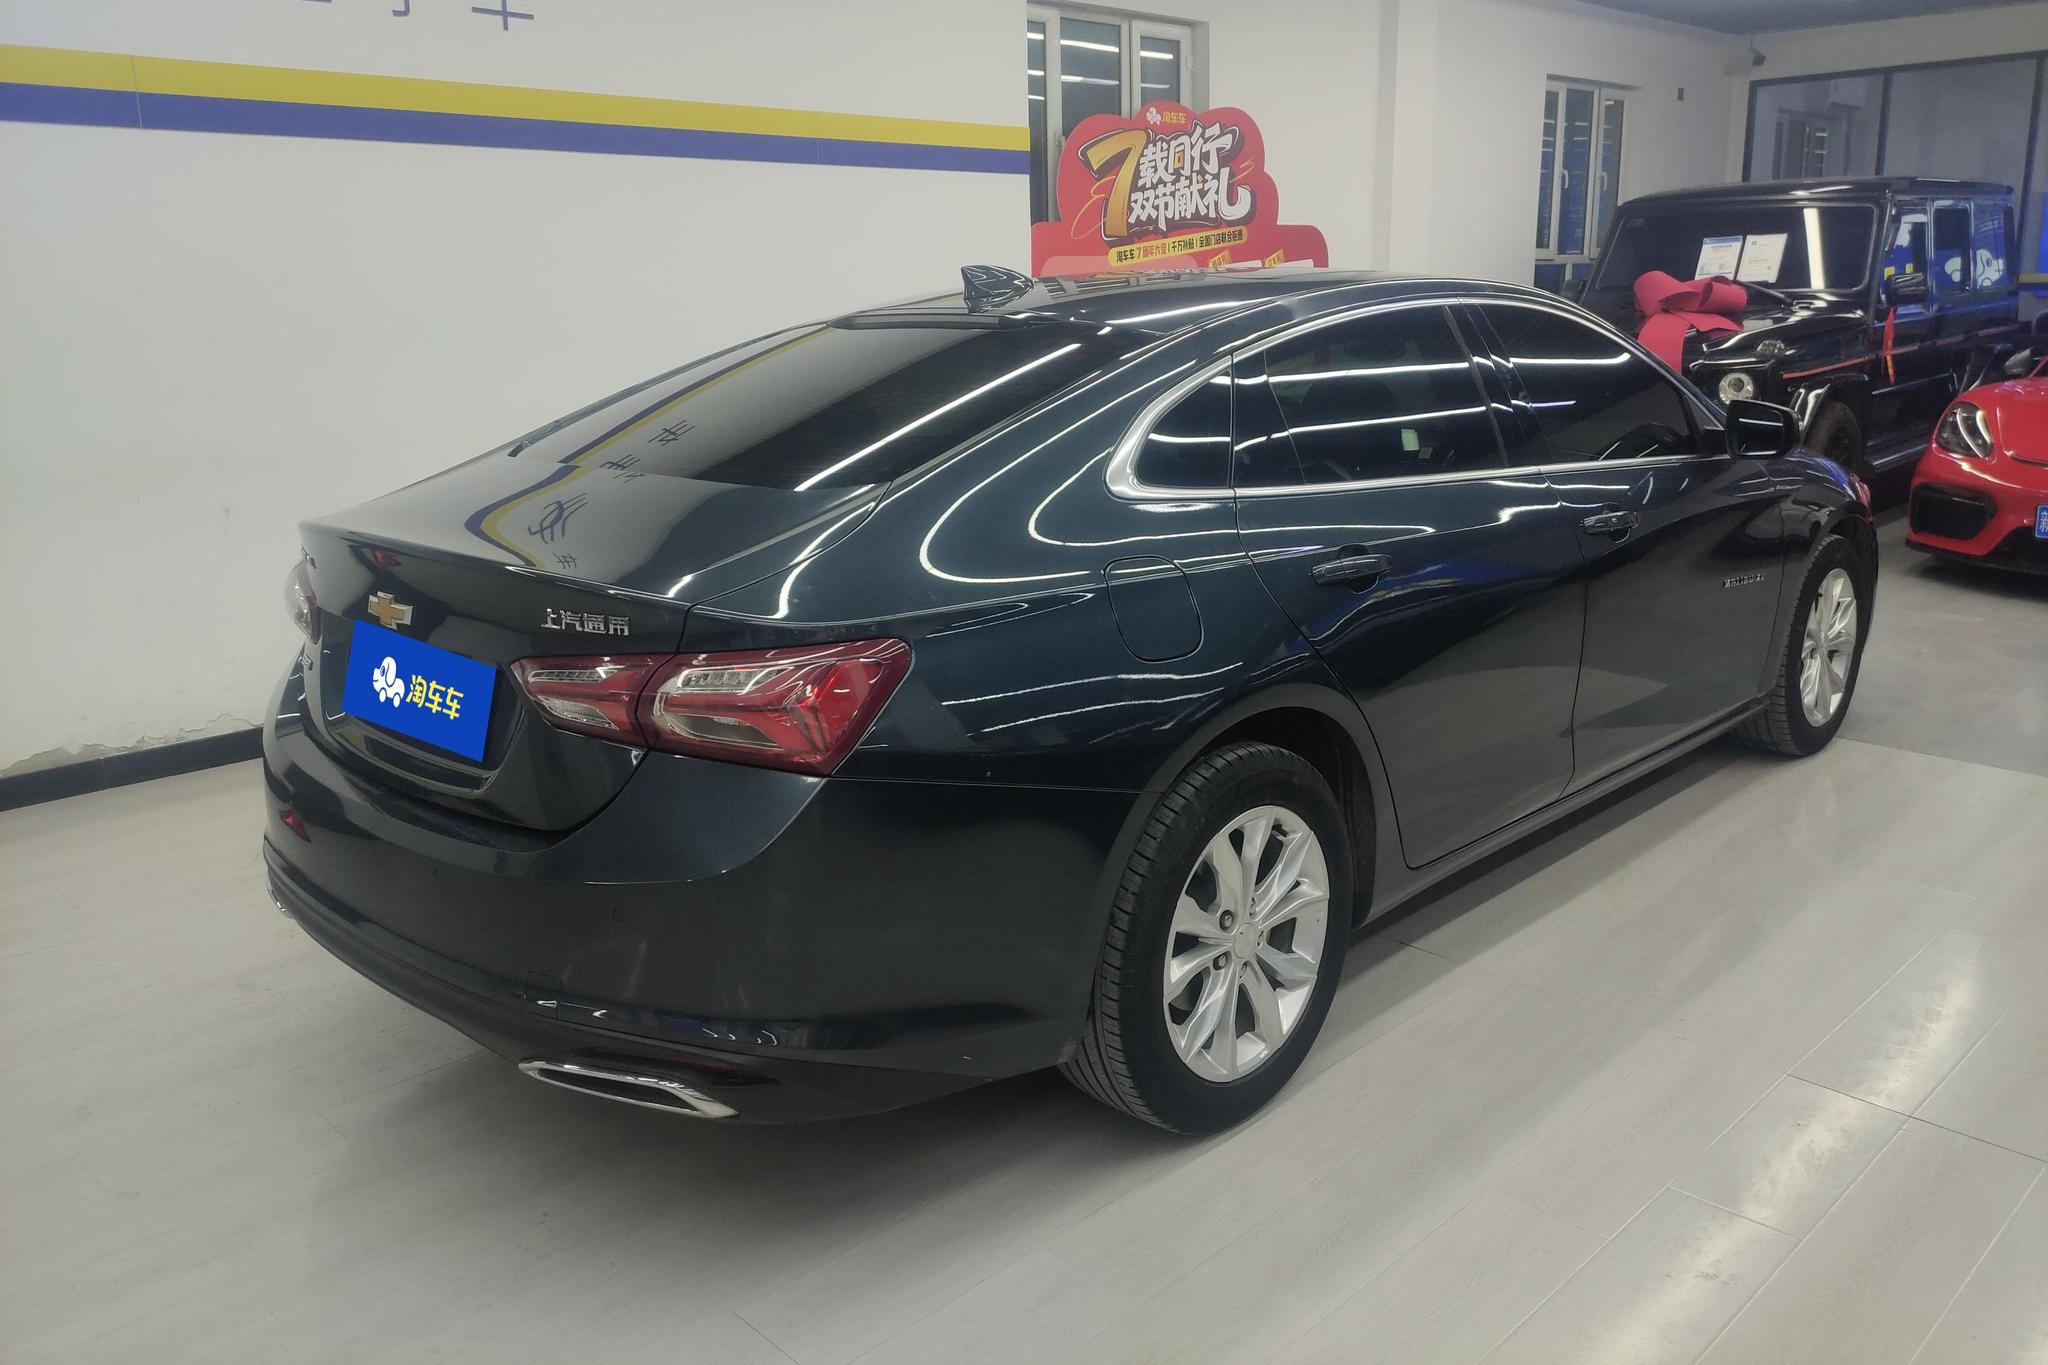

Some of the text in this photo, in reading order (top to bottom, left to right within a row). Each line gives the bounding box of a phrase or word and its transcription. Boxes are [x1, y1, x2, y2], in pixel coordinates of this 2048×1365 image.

[1162, 111, 1186, 124] 淘车车
[1127, 166, 1252, 232] 双节献礼
[540, 608, 630, 636] 上汽通用
